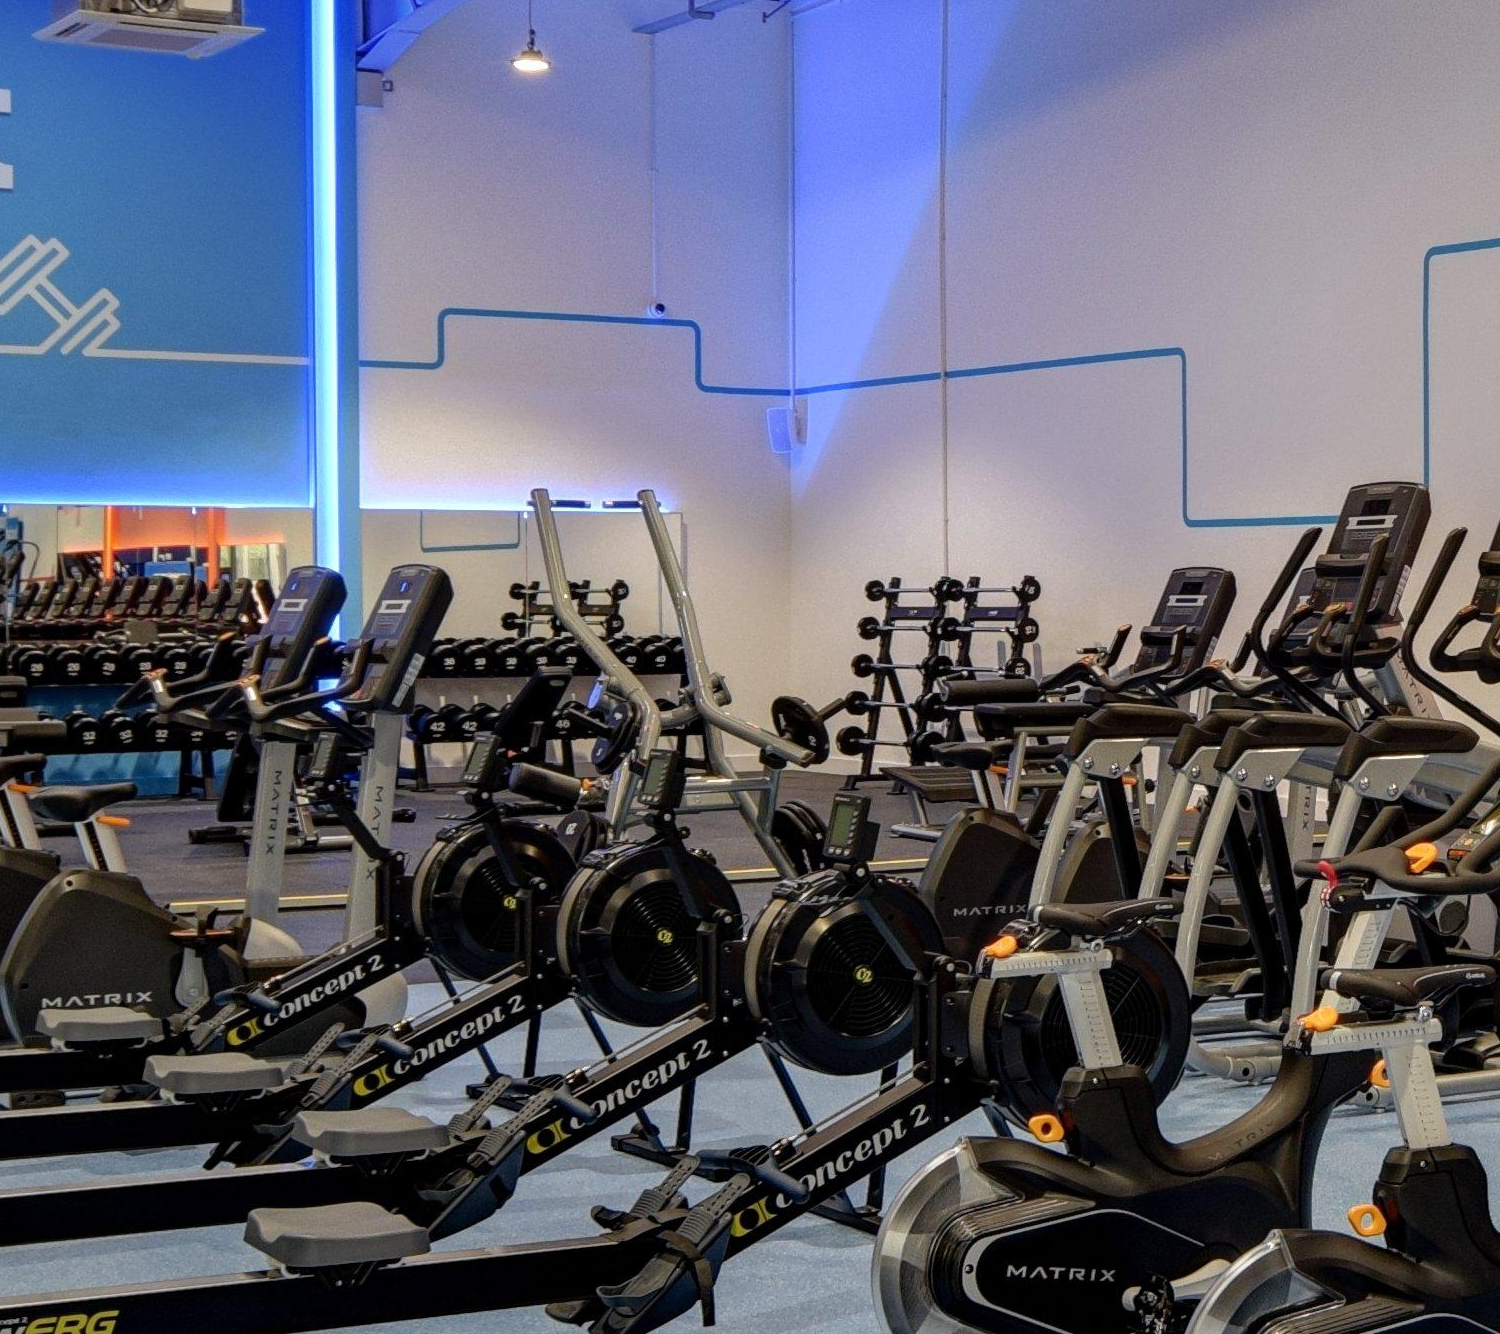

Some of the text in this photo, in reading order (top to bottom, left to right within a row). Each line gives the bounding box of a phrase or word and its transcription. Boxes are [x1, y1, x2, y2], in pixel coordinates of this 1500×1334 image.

[265, 770, 283, 855] MATRIX
[365, 785, 385, 879] MATIX
[657, 929, 673, 944] C2
[952, 903, 1028, 917] MATRIX
[41, 991, 152, 1009] MATRIX
[263, 953, 385, 1027] concept 2
[856, 968, 873, 984] C2
[393, 994, 527, 1075] concept 2
[569, 1038, 712, 1130] concept 2
[775, 1103, 931, 1209] concept 2
[1006, 1264, 1116, 1282] MATRIX
